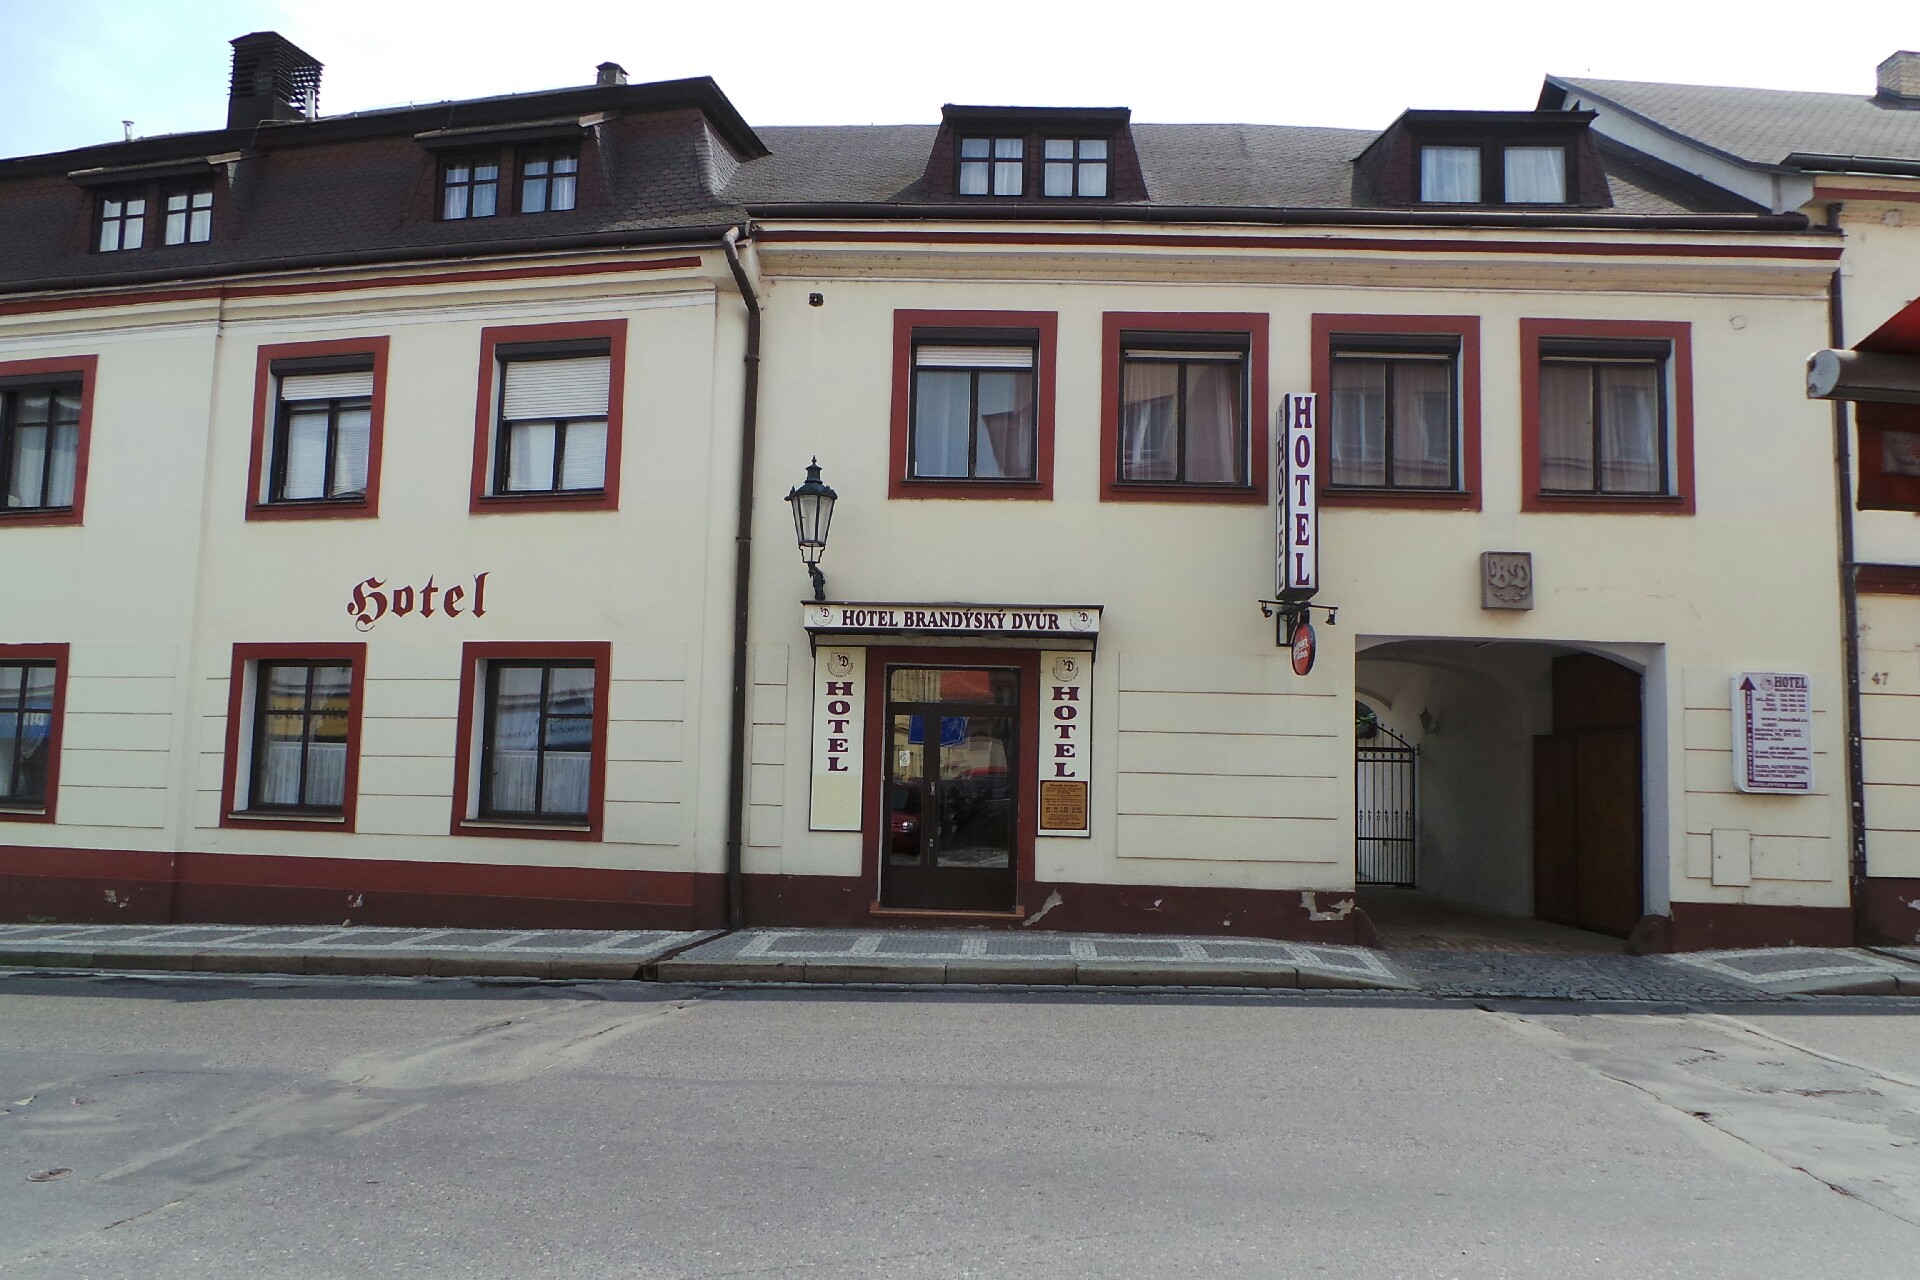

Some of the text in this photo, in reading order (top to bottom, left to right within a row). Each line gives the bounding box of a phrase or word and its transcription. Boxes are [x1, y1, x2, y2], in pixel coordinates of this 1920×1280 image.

[1277, 438, 1286, 591] HOTEL
[1293, 396, 1313, 586] HOTEL
[346, 571, 490, 632] Hotel
[841, 610, 899, 627] HOTEL
[903, 608, 1008, 630] BRANDÝSKÝ
[1011, 608, 1061, 630] DVŮR
[1774, 676, 1808, 689] HOTEL
[1871, 671, 1890, 686] 47
[825, 681, 854, 772] HOTEL
[1051, 686, 1080, 778] HOTEL
